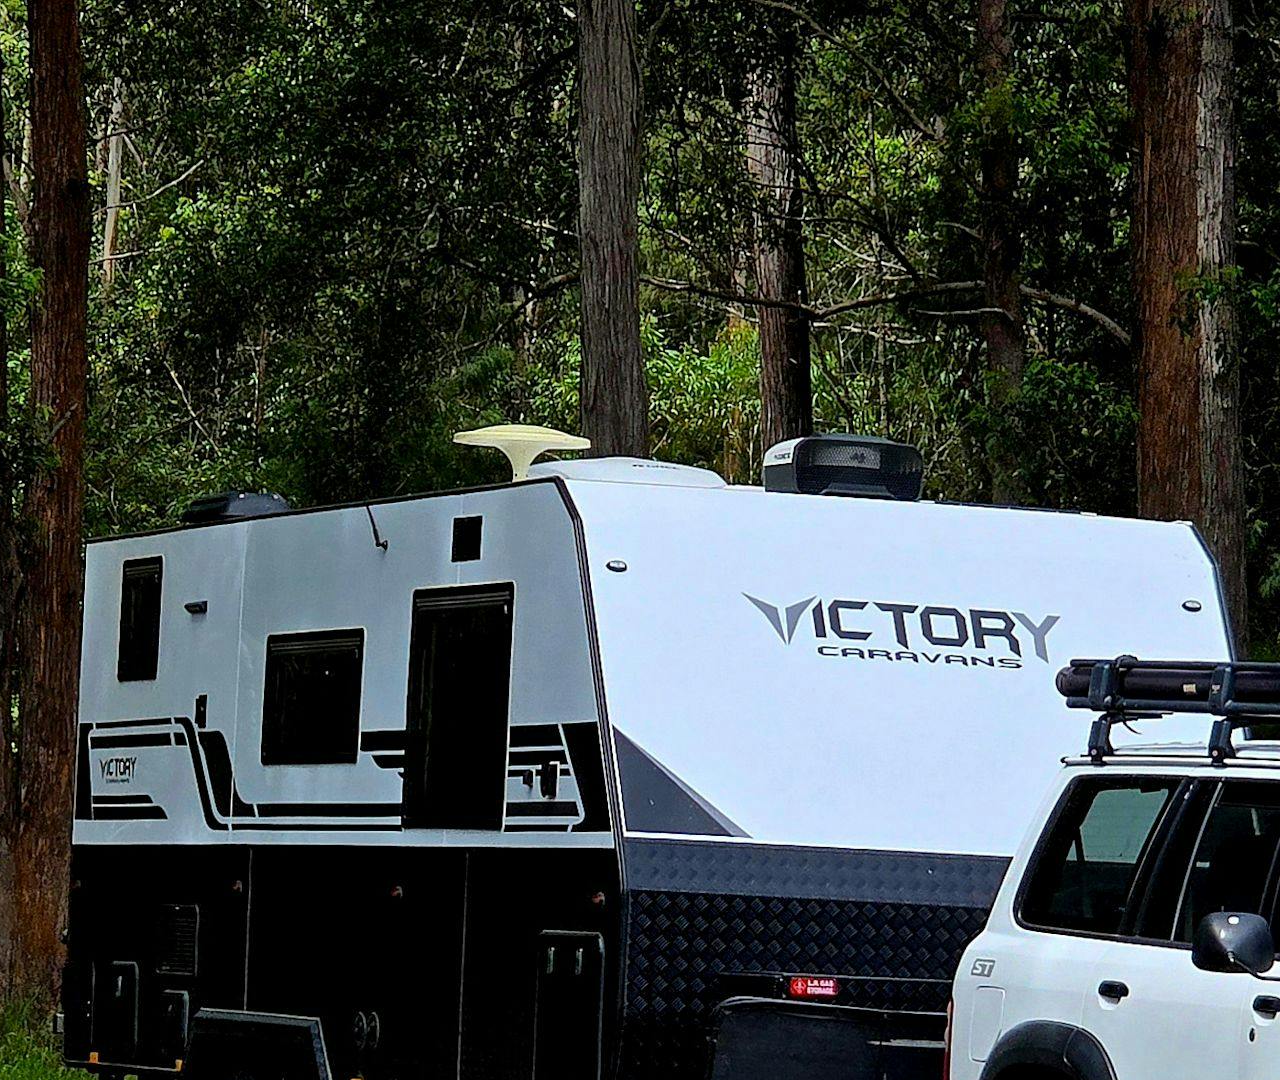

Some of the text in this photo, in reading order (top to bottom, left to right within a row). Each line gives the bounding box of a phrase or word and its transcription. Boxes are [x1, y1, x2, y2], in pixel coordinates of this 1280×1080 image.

[740, 591, 1061, 664] VICTORY
[817, 646, 1023, 669] CARAVANS
[972, 961, 995, 975] ST
